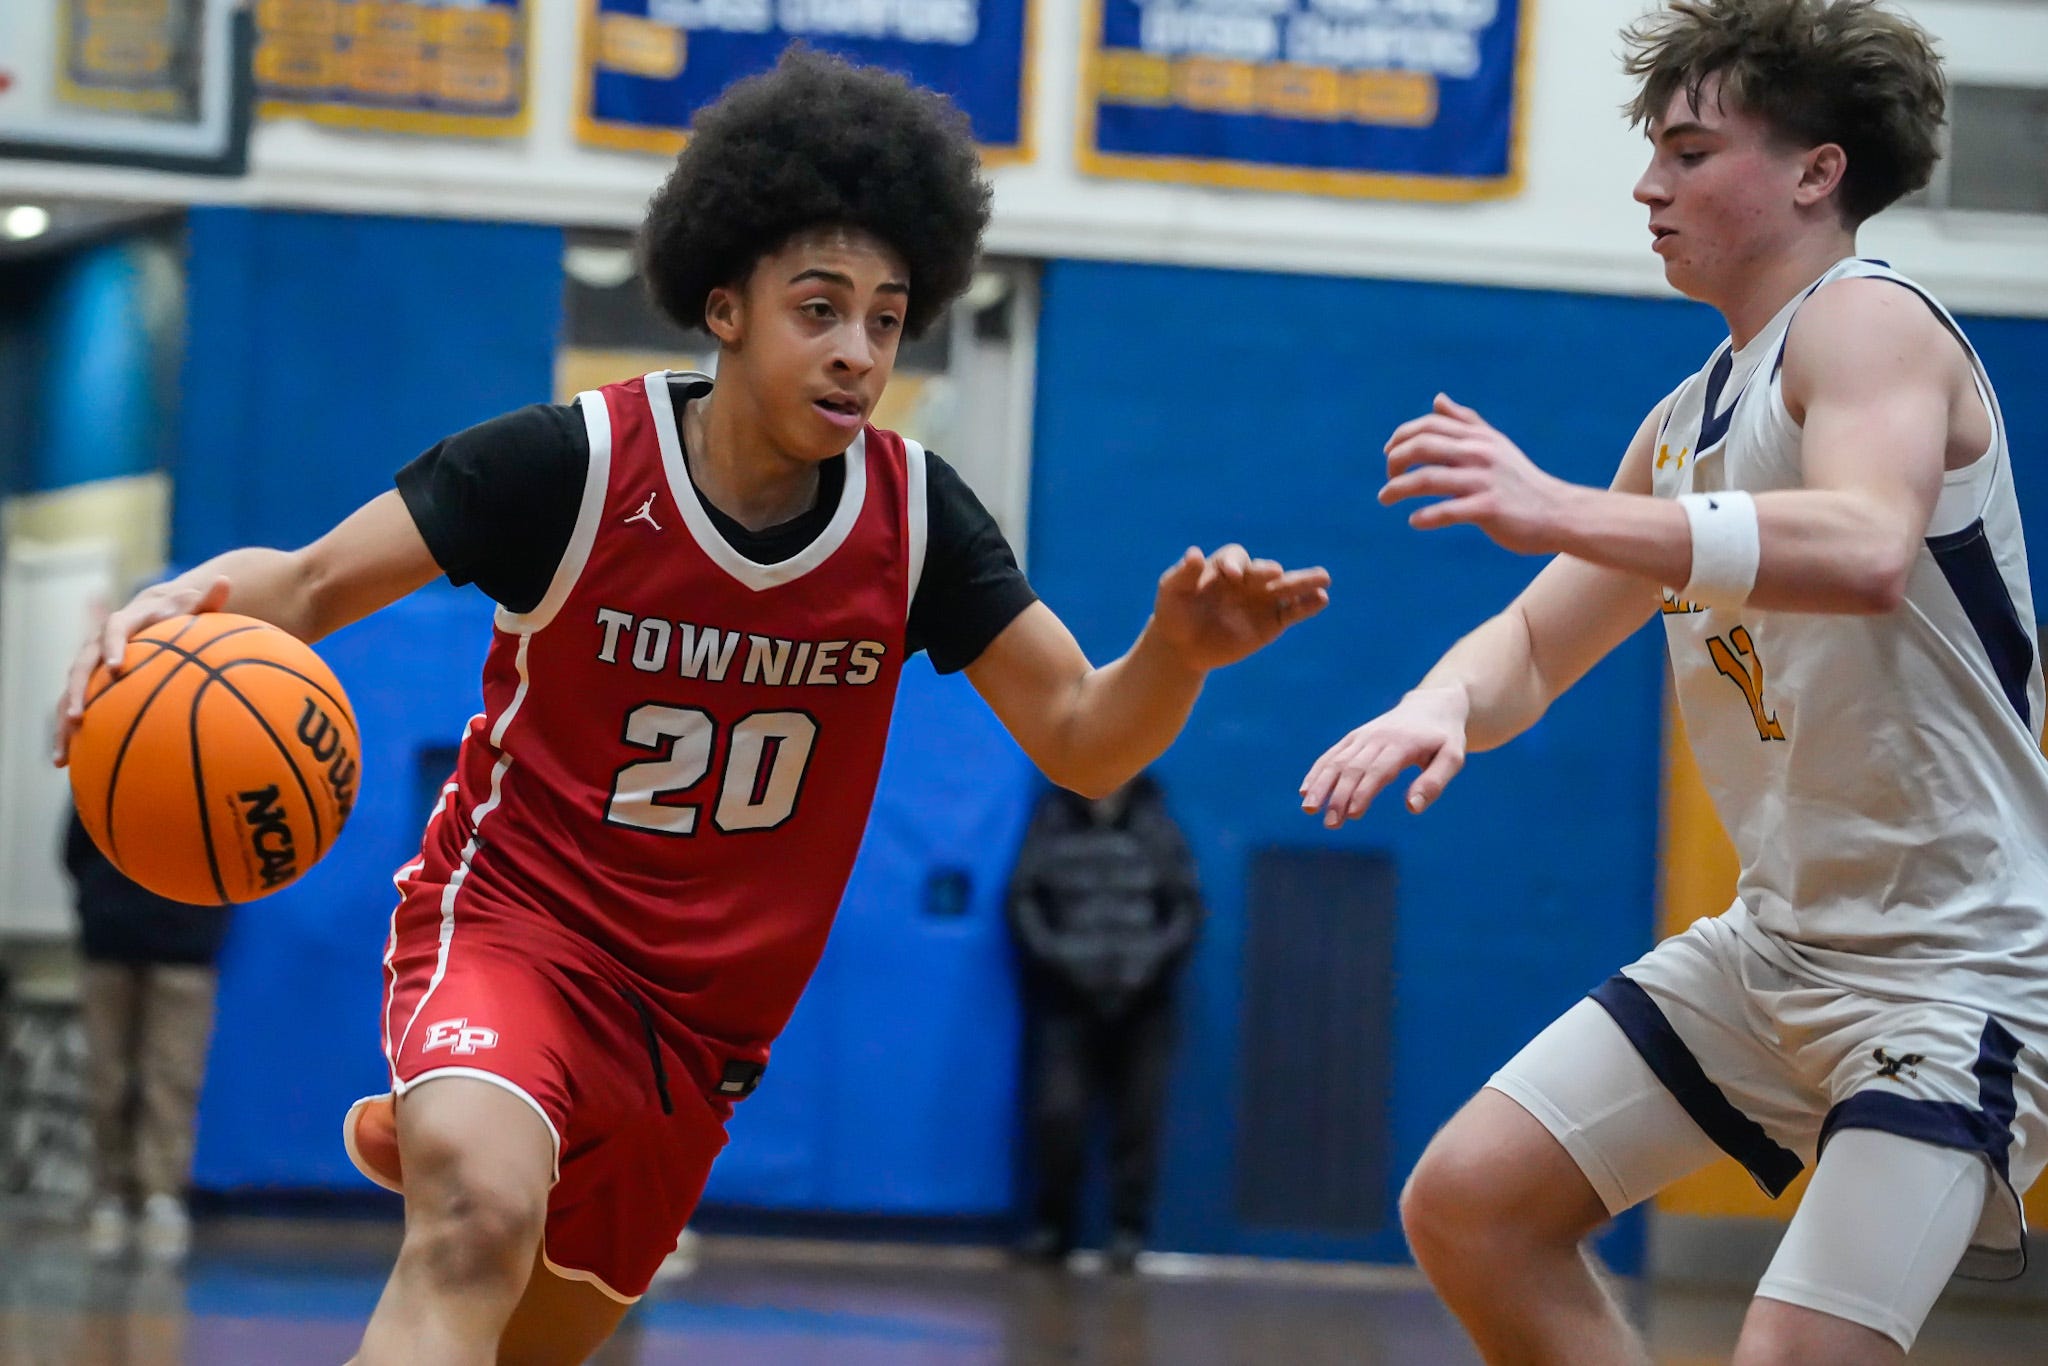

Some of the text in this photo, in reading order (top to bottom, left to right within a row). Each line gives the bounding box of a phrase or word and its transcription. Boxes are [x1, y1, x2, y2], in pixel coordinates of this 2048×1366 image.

[596, 606, 887, 687] TOWNIES
[602, 700, 822, 838] 20
[422, 1017, 499, 1056] EP
